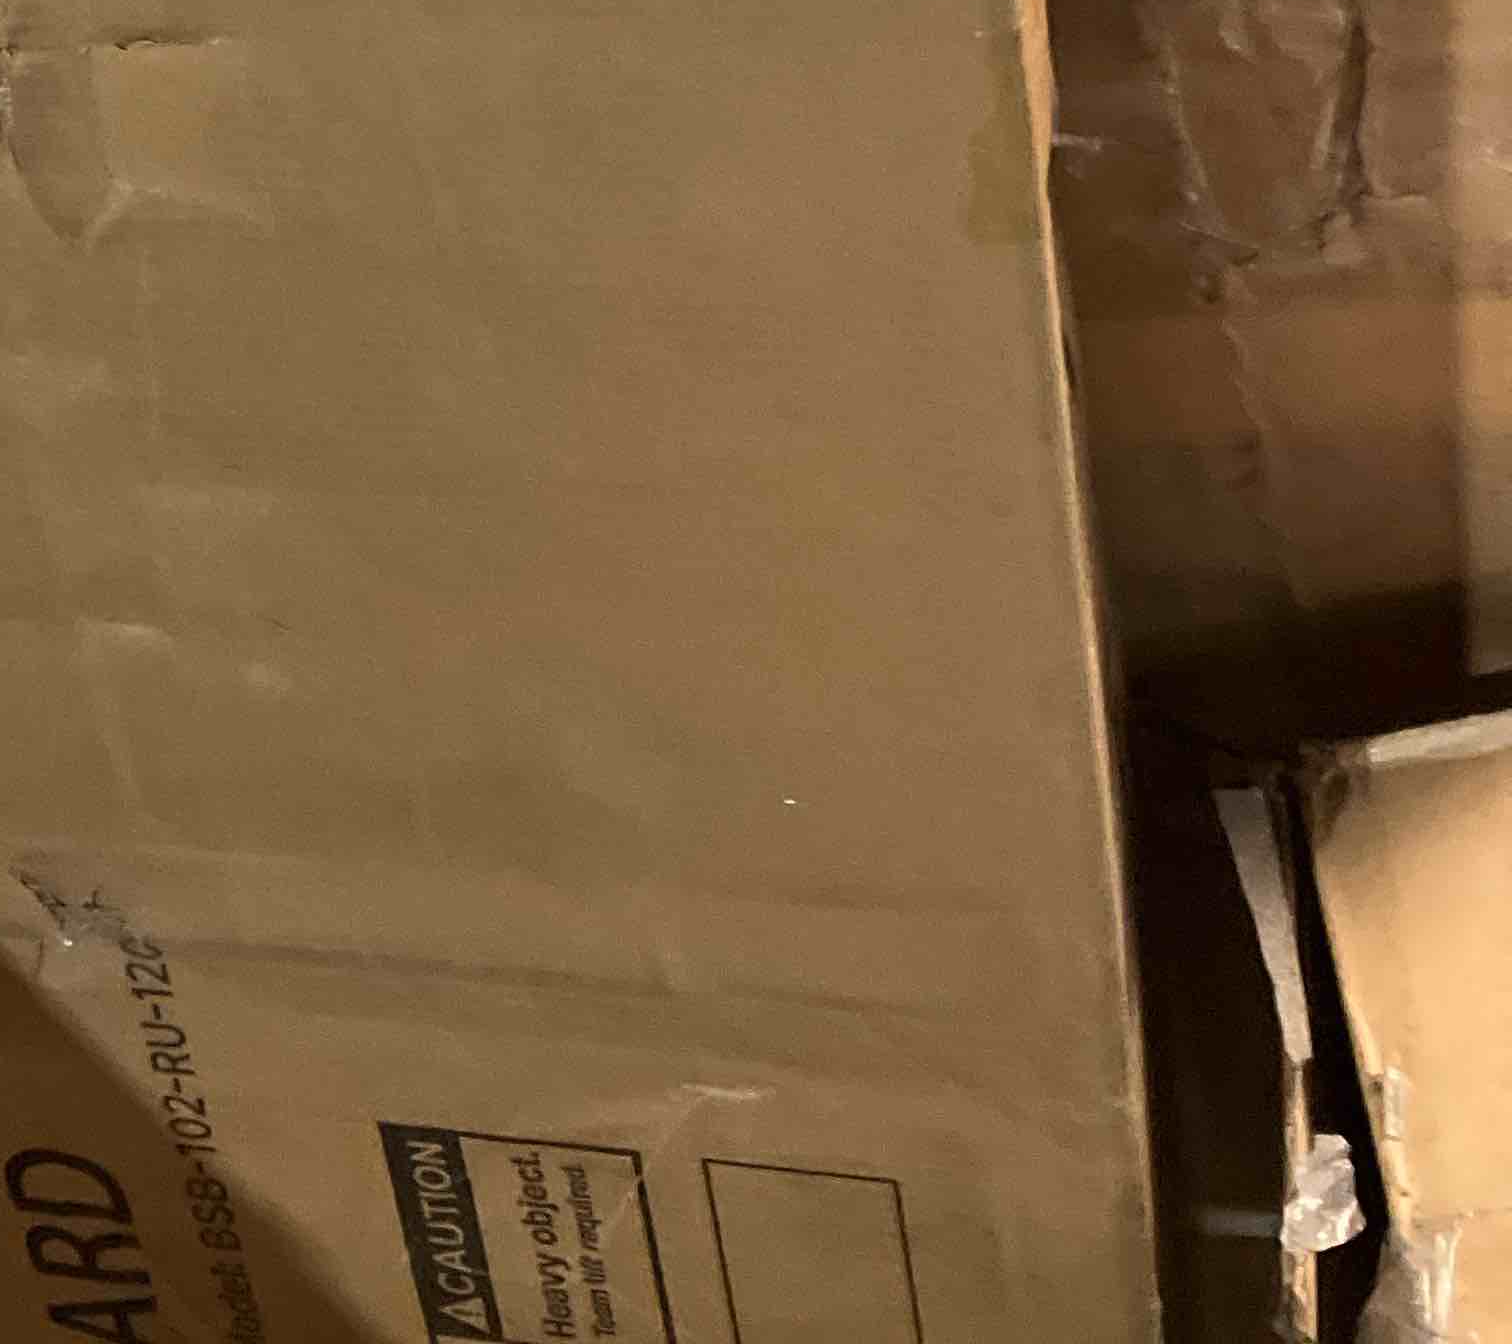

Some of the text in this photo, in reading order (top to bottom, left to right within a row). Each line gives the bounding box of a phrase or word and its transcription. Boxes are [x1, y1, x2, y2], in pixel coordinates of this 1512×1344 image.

[405, 1139, 477, 1297] CAUTION
[508, 1150, 578, 1339] Heavy object.
[578, 1254, 609, 1285] lift
[590, 1288, 617, 1337] Team
